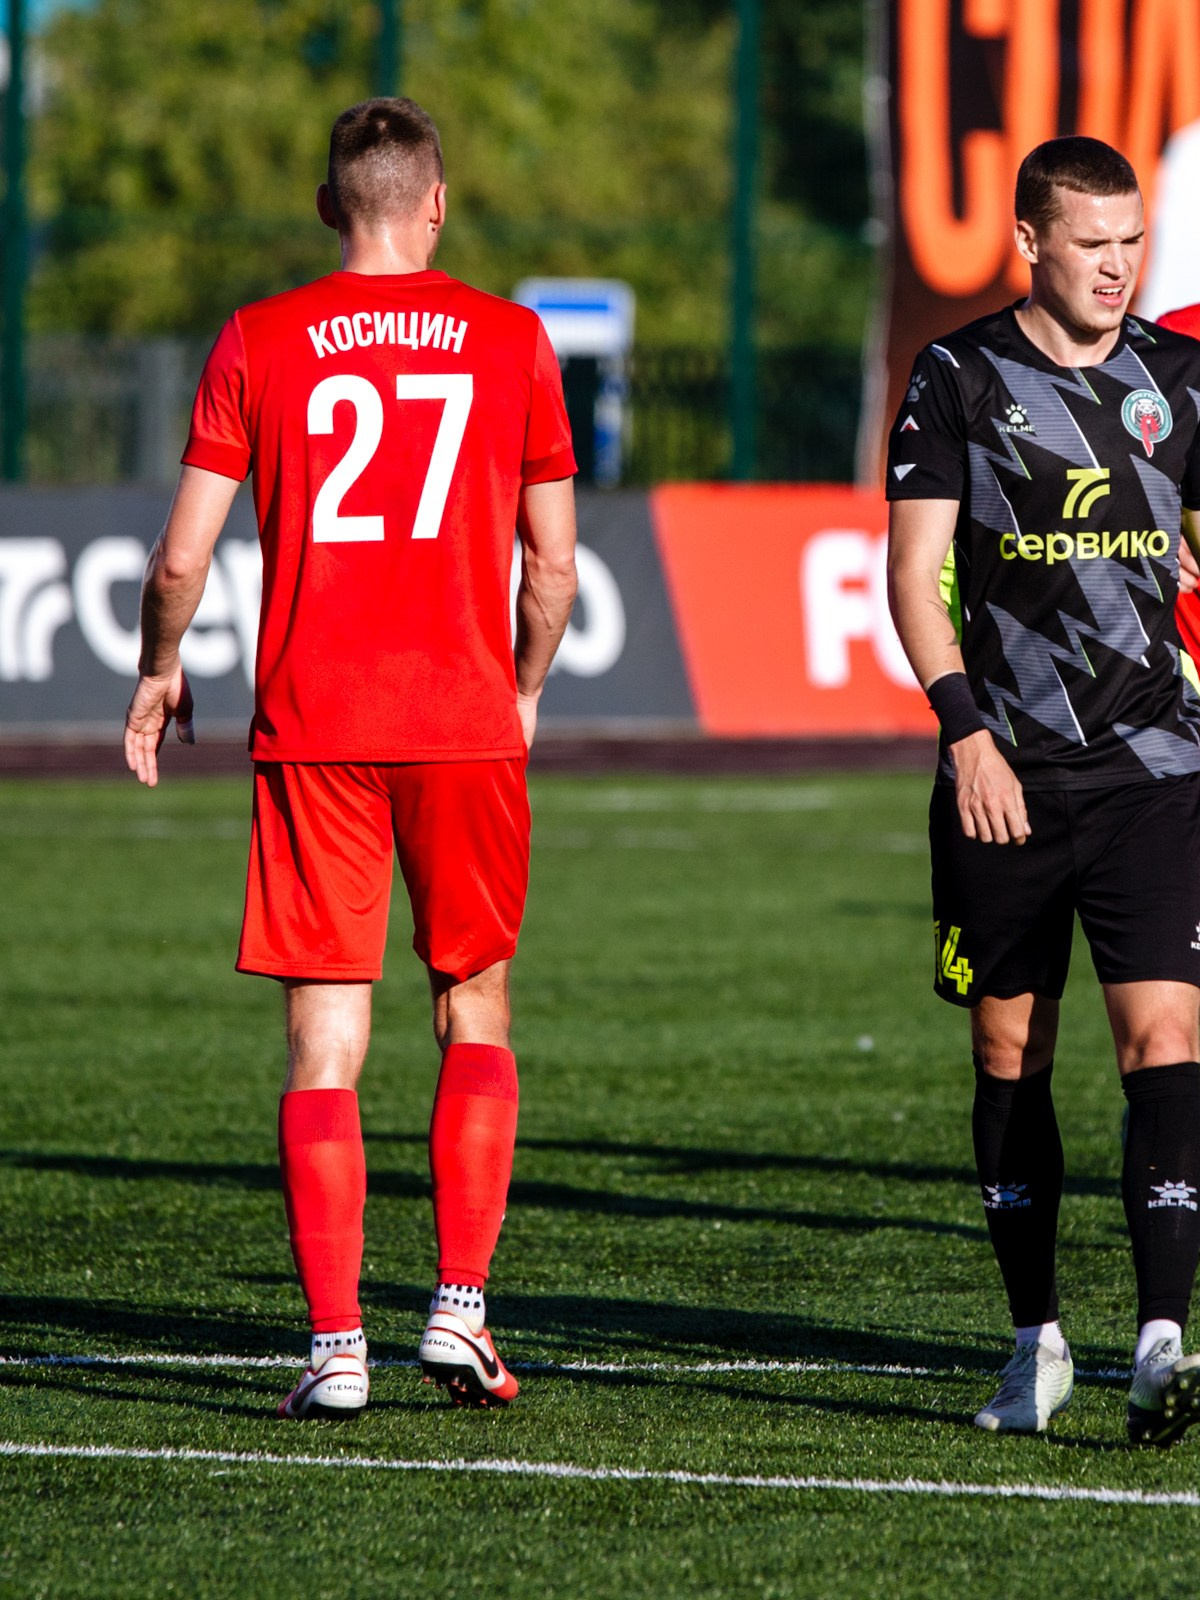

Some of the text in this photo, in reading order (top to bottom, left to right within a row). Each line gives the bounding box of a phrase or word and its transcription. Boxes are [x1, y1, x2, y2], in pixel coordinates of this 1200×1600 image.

[307, 311, 468, 359] КОСИЦИН
[1000, 424, 1035, 433] KELME
[307, 374, 473, 543] 27
[1000, 529, 1170, 565] сервико
[983, 1199, 1031, 1209] KELME
[1148, 1198, 1198, 1211] KELME
[327, 1384, 364, 1393] TIEMPO
